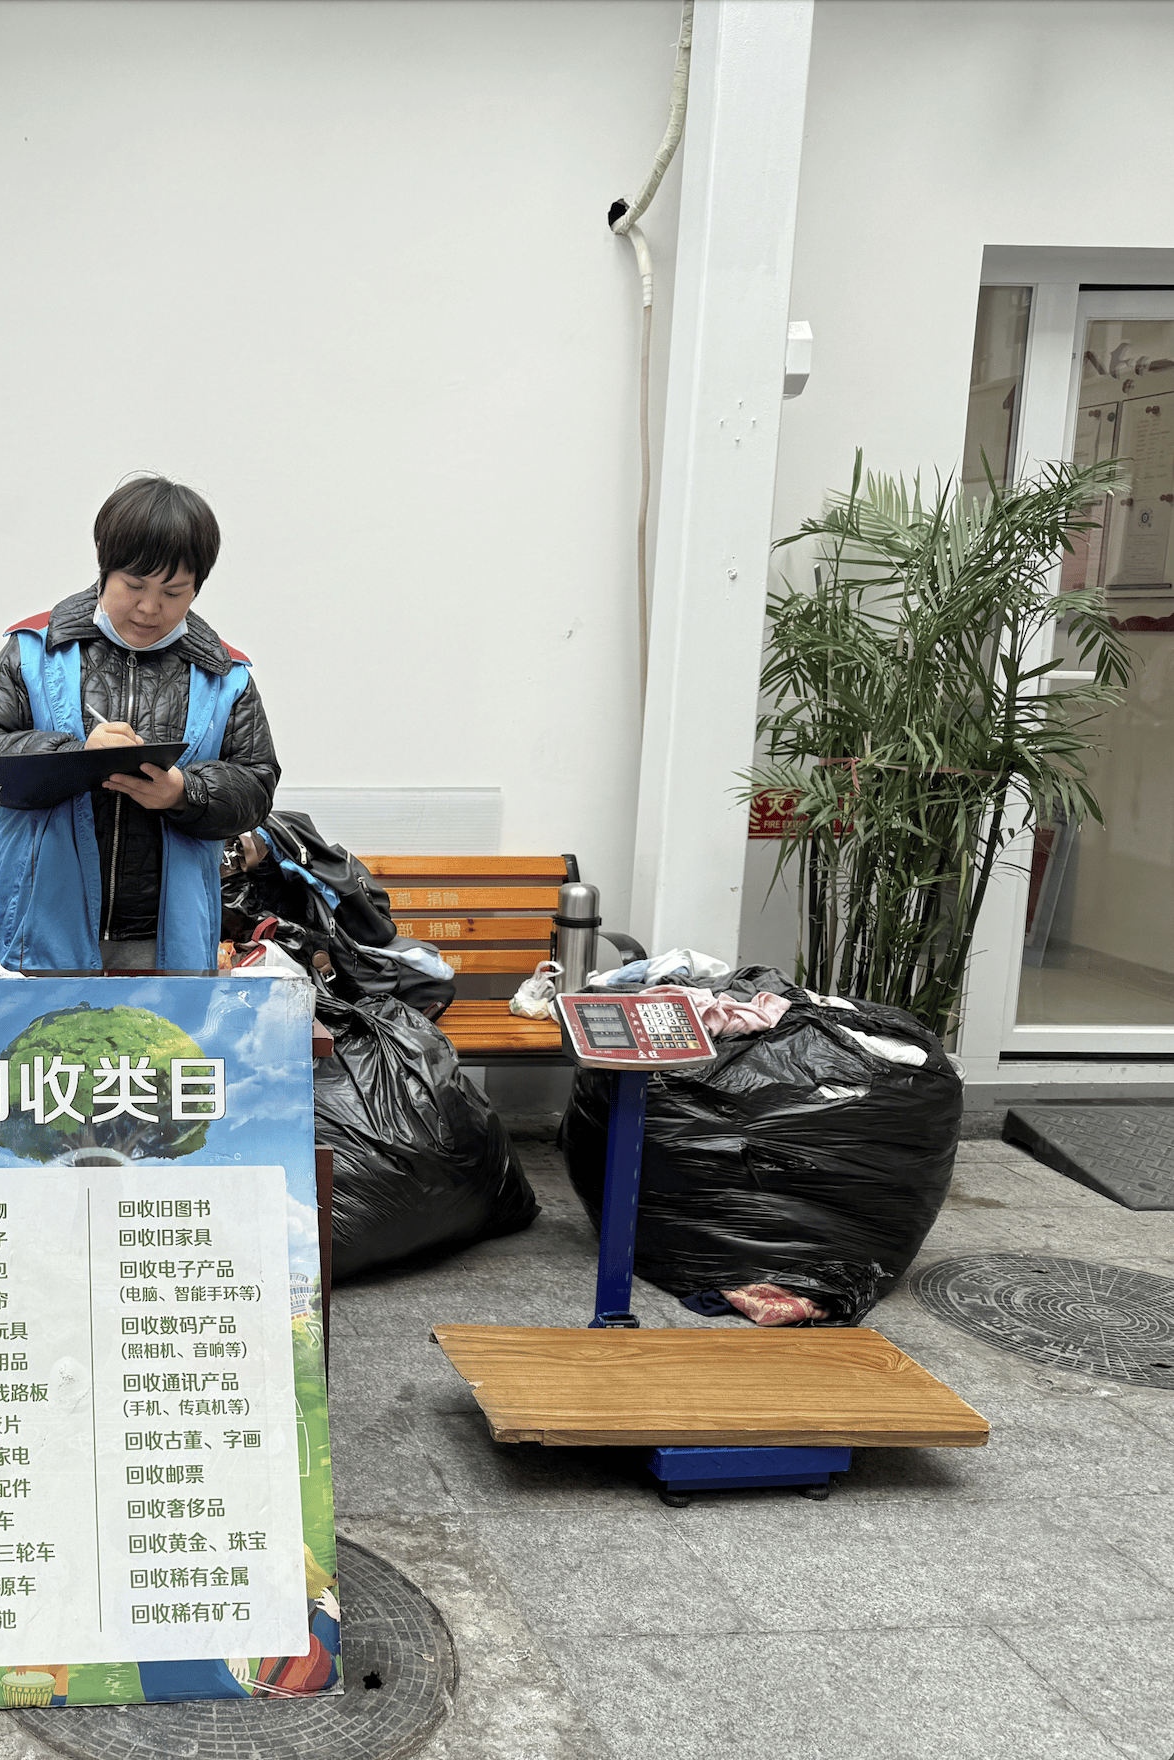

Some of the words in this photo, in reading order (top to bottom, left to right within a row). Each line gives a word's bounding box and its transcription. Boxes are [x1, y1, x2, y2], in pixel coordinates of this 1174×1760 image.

[764, 820, 780, 829] FIRE
[428, 922, 461, 937] 捐赠
[119, 1200, 210, 1218] 回收旧图书
[119, 1228, 212, 1246] 回收旧家具
[120, 1260, 234, 1279] 回收电子产品
[122, 1316, 236, 1335] 回收数码产品
[124, 1372, 238, 1392] 回收通讯产品
[125, 1430, 261, 1450] 回收古董、字画
[126, 1465, 204, 1484] 回收邮票
[128, 1498, 225, 1519] 回收奢侈品
[129, 1531, 267, 1553] 回收黄金、珠宝
[130, 1567, 249, 1588] 回收稀有金属
[132, 1602, 250, 1624] 回收稀有矿石
